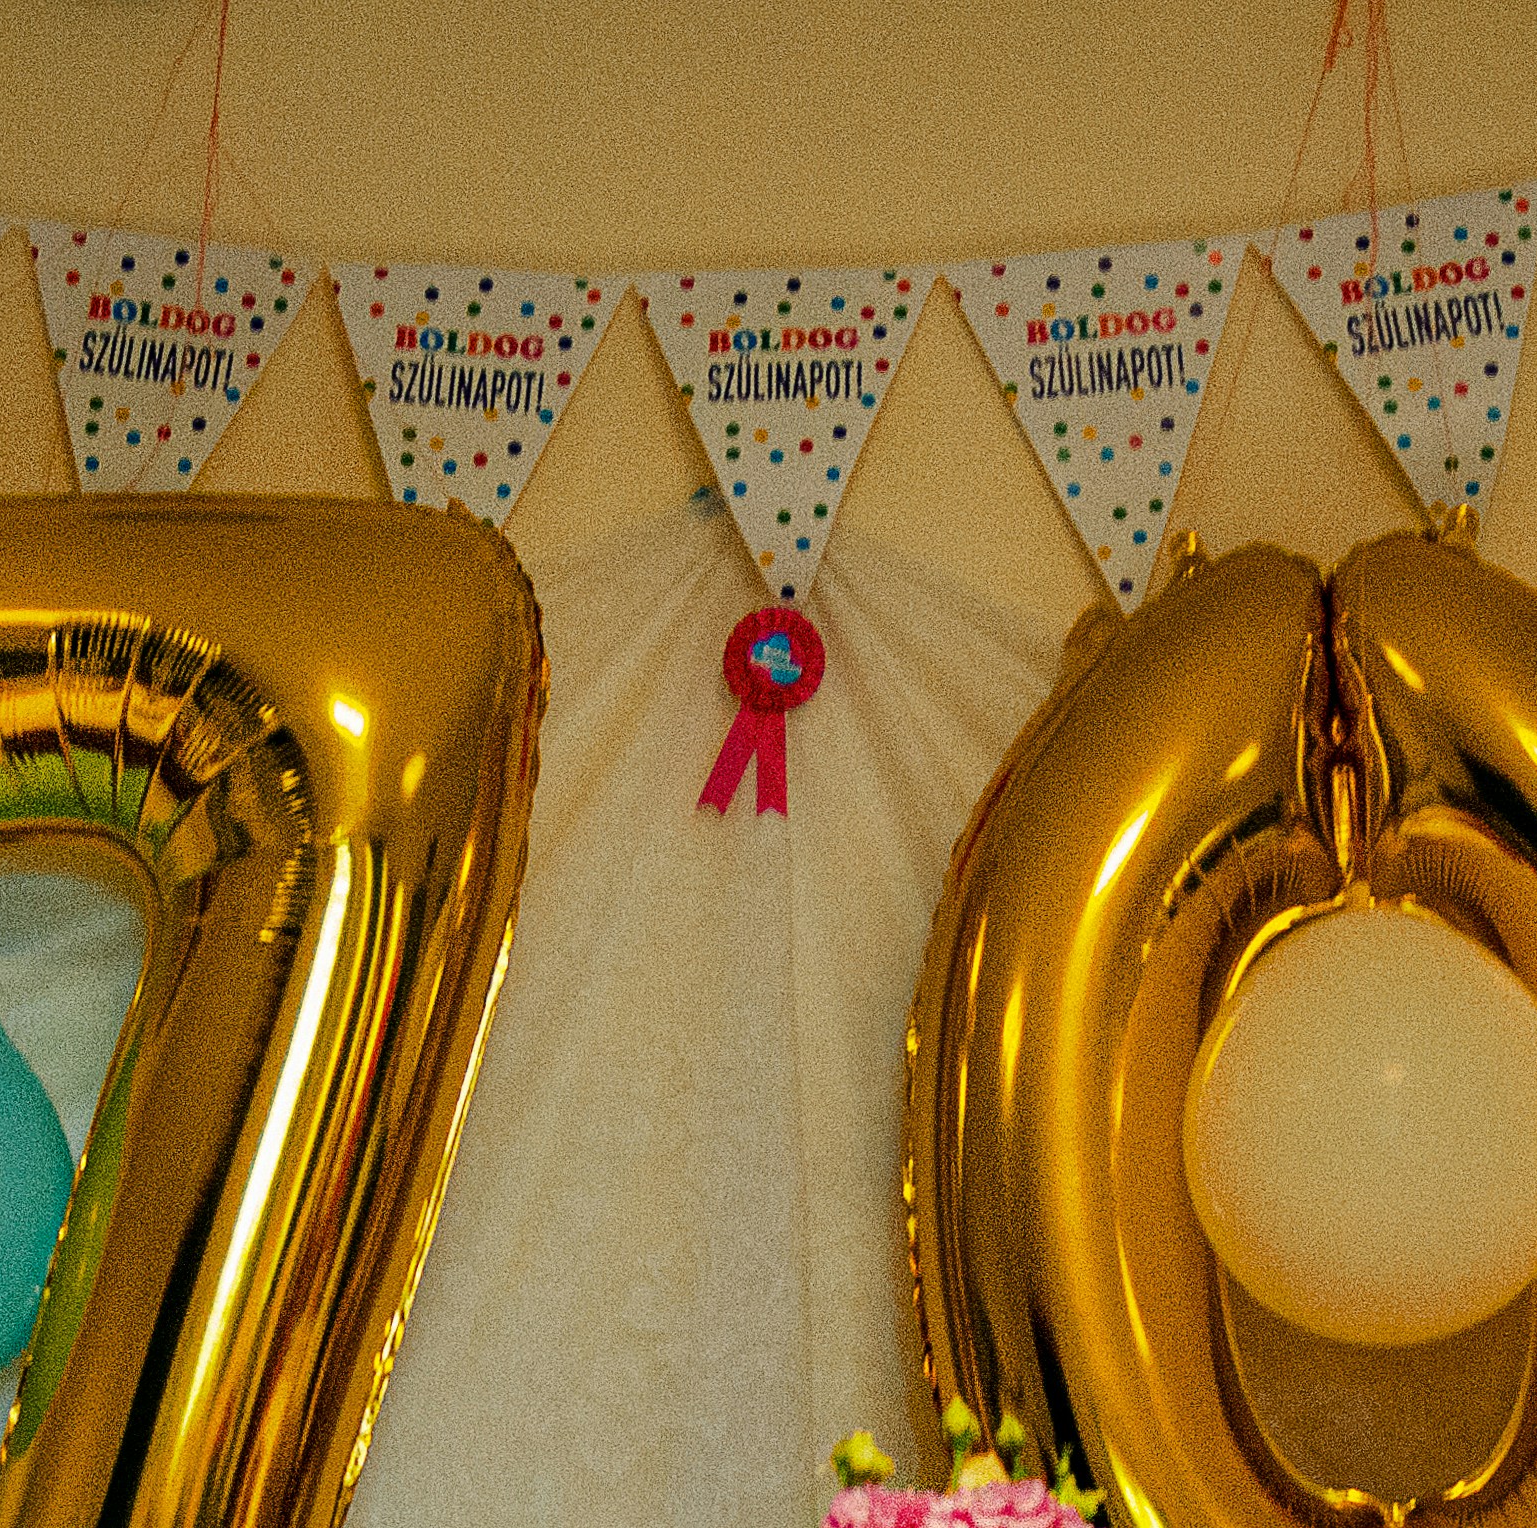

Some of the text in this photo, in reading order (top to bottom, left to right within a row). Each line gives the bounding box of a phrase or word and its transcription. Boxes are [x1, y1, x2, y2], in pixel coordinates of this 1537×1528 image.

[1339, 257, 1491, 305] BOLDOG
[89, 293, 236, 337] BOLDOG
[1026, 308, 1177, 347] BOLDOG
[1346, 291, 1504, 356] SZÜLINAPOT!
[79, 330, 234, 393] SZÜLINAPOT!
[395, 323, 545, 361] BOLDOG
[708, 326, 860, 355] BOLDOG
[389, 357, 546, 414] SZÜLINAPOT!
[707, 355, 863, 402] SZÜLINAPOT!
[1029, 344, 1186, 400] SZÜLINAPOT!
